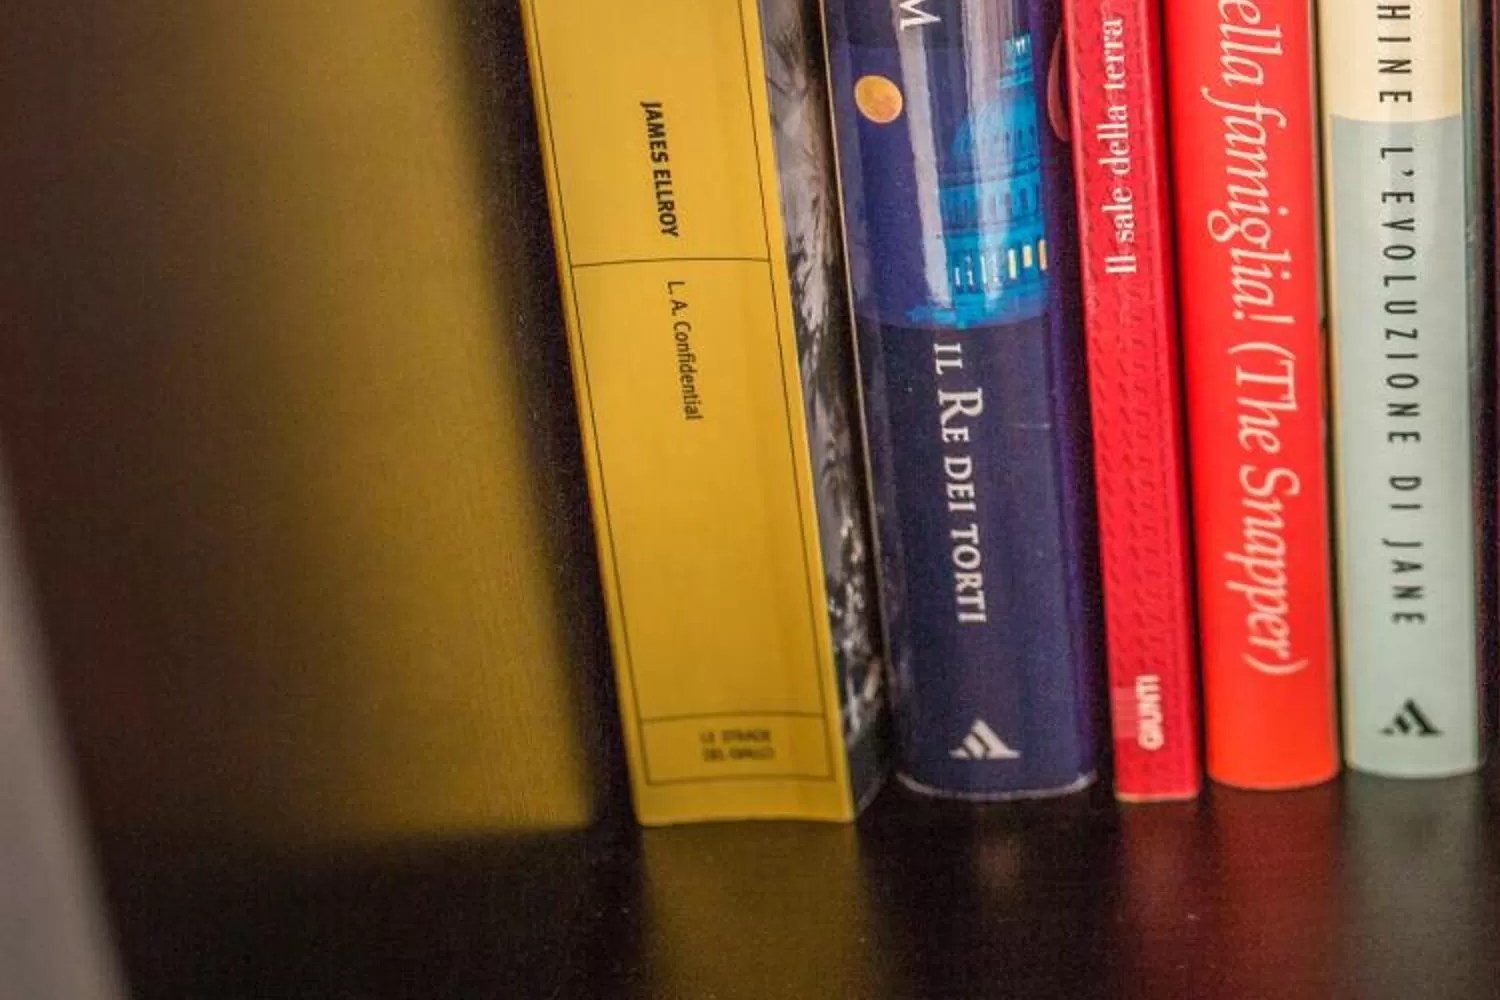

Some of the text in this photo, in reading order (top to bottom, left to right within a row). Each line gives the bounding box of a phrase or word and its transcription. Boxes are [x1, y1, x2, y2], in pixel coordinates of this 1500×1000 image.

[640, 101, 679, 238] JAMES ELLROY
[1097, 18, 1137, 274] Il sale della terra
[1202, 86, 1295, 324] famiglia!
[673, 320, 704, 422] Confidential
[1228, 341, 1297, 455] (The
[944, 456, 977, 512] DEI
[1389, 476, 1422, 509] DI
[950, 523, 987, 623] TORTI
[1225, 465, 1309, 675] Snapper)
[1381, 538, 1426, 624] JANE
